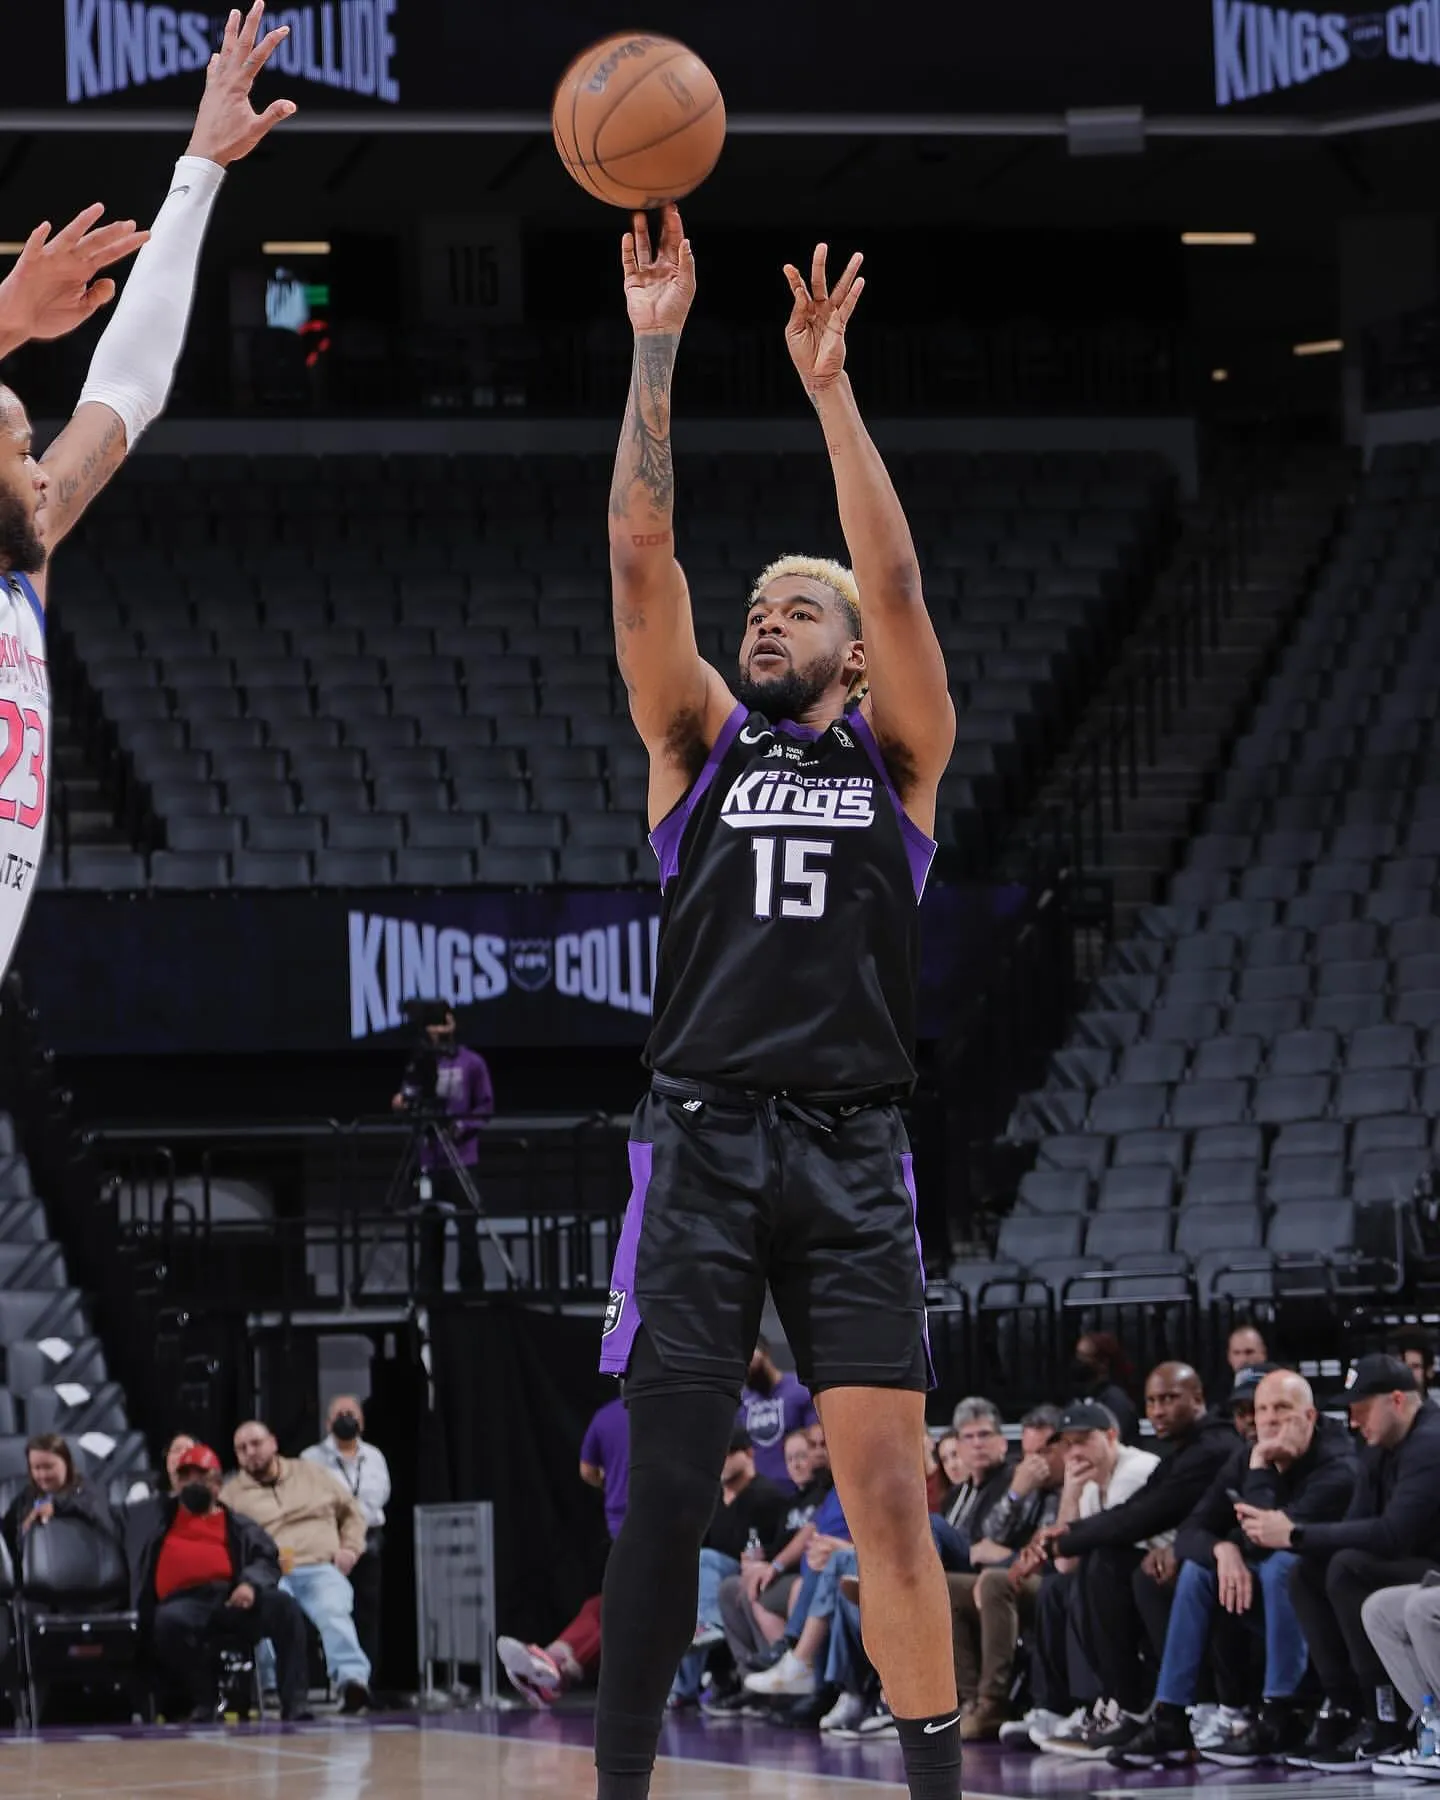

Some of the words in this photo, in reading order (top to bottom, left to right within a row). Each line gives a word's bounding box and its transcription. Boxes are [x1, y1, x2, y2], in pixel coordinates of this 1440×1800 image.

[64, 0, 211, 104] KINGS
[1213, 0, 1350, 107] KINGS
[447, 245, 499, 307] 115
[0, 698, 46, 830] 23
[0, 852, 35, 891] T&T
[752, 836, 834, 918] 15
[348, 910, 508, 1041] KINGS
